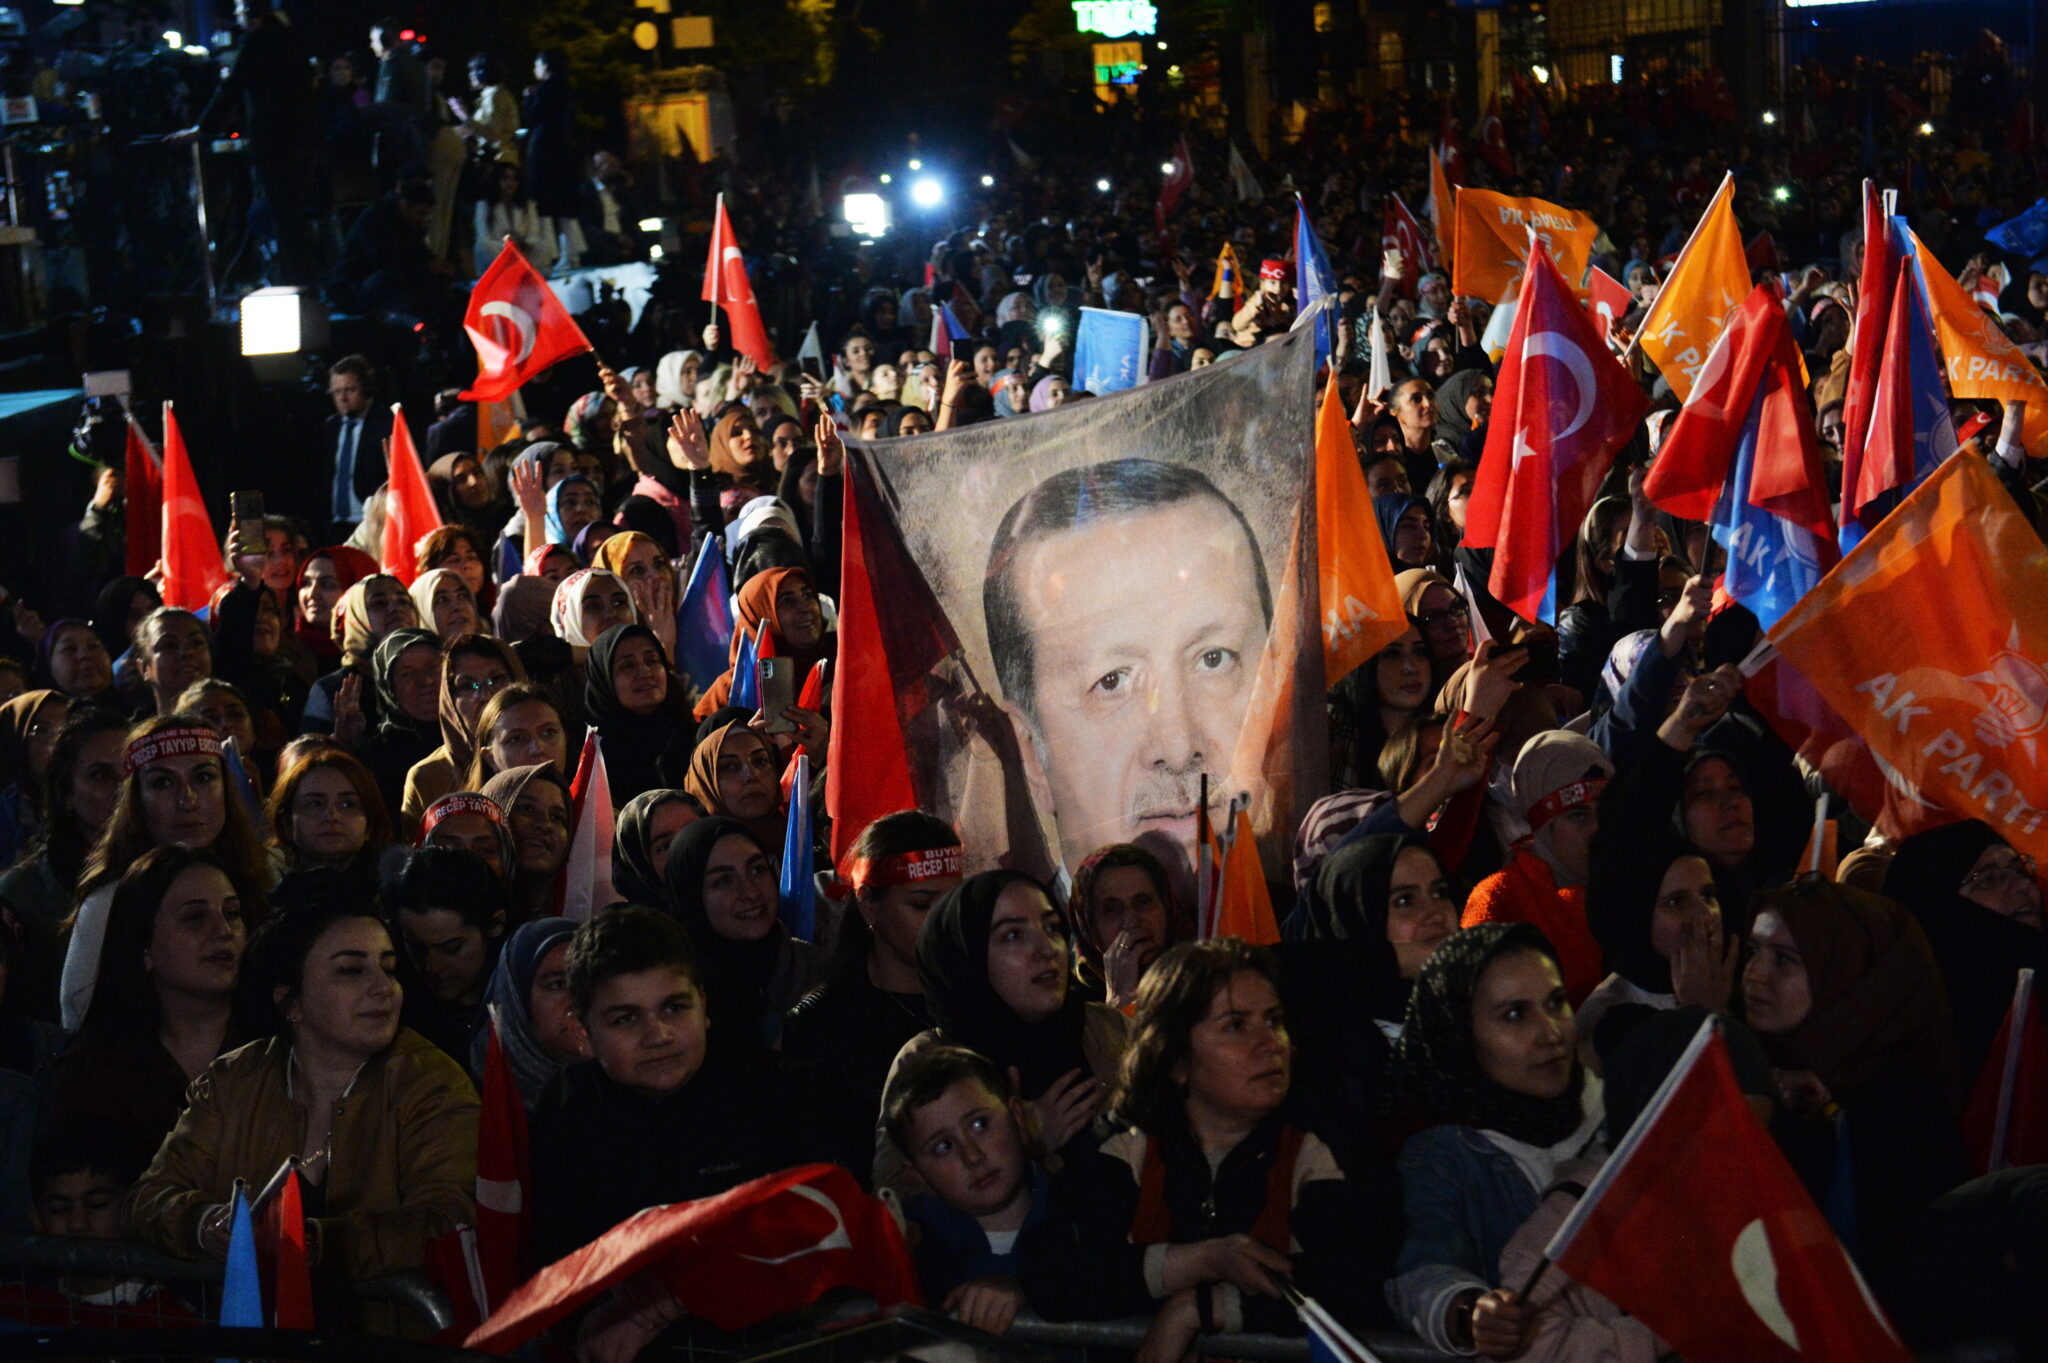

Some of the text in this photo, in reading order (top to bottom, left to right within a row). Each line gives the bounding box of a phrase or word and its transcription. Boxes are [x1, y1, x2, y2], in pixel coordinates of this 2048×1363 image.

[1855, 672, 1933, 736] AK
[435, 801, 466, 819] RECEP
[908, 859, 943, 879] RECEP
